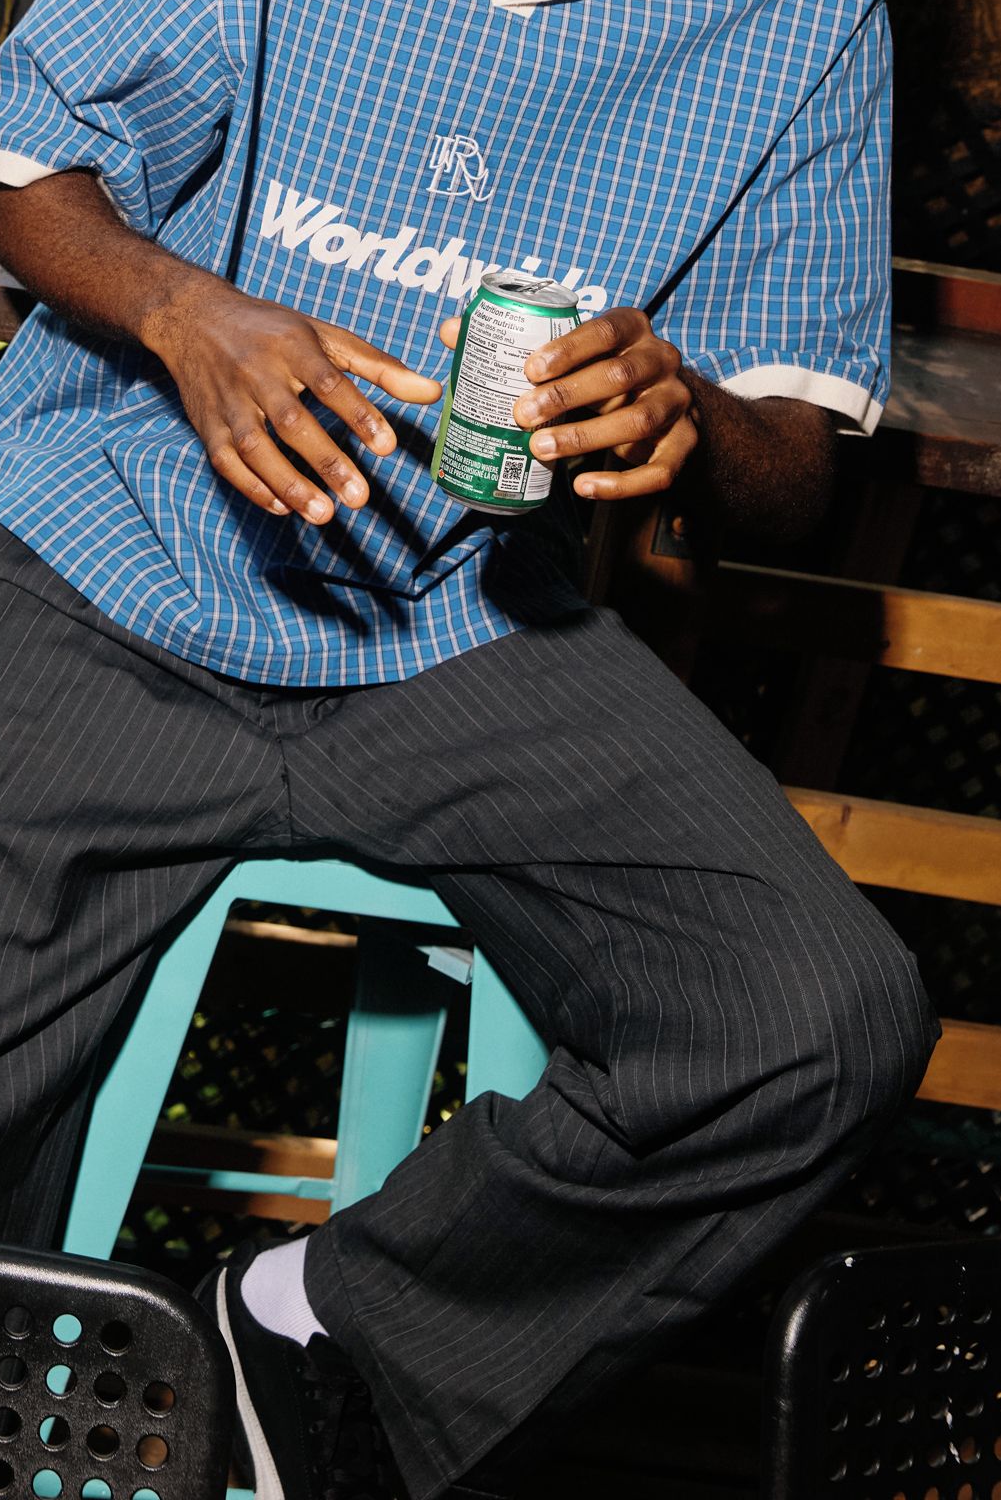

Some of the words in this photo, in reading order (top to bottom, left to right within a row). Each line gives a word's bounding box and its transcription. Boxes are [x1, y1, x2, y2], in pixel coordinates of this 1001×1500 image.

[474, 309, 493, 322] Valeur
[492, 319, 525, 332] nutritive
[480, 301, 504, 317] Nutrition
[505, 311, 525, 323] Facts
[467, 332, 486, 345] Calories
[487, 341, 498, 349] 140
[493, 361, 515, 372] Glucides
[455, 453, 464, 461] FOR
[463, 456, 482, 469] REFUND
[481, 462, 499, 472] WHERE
[453, 467, 474, 482] PRESCRIT
